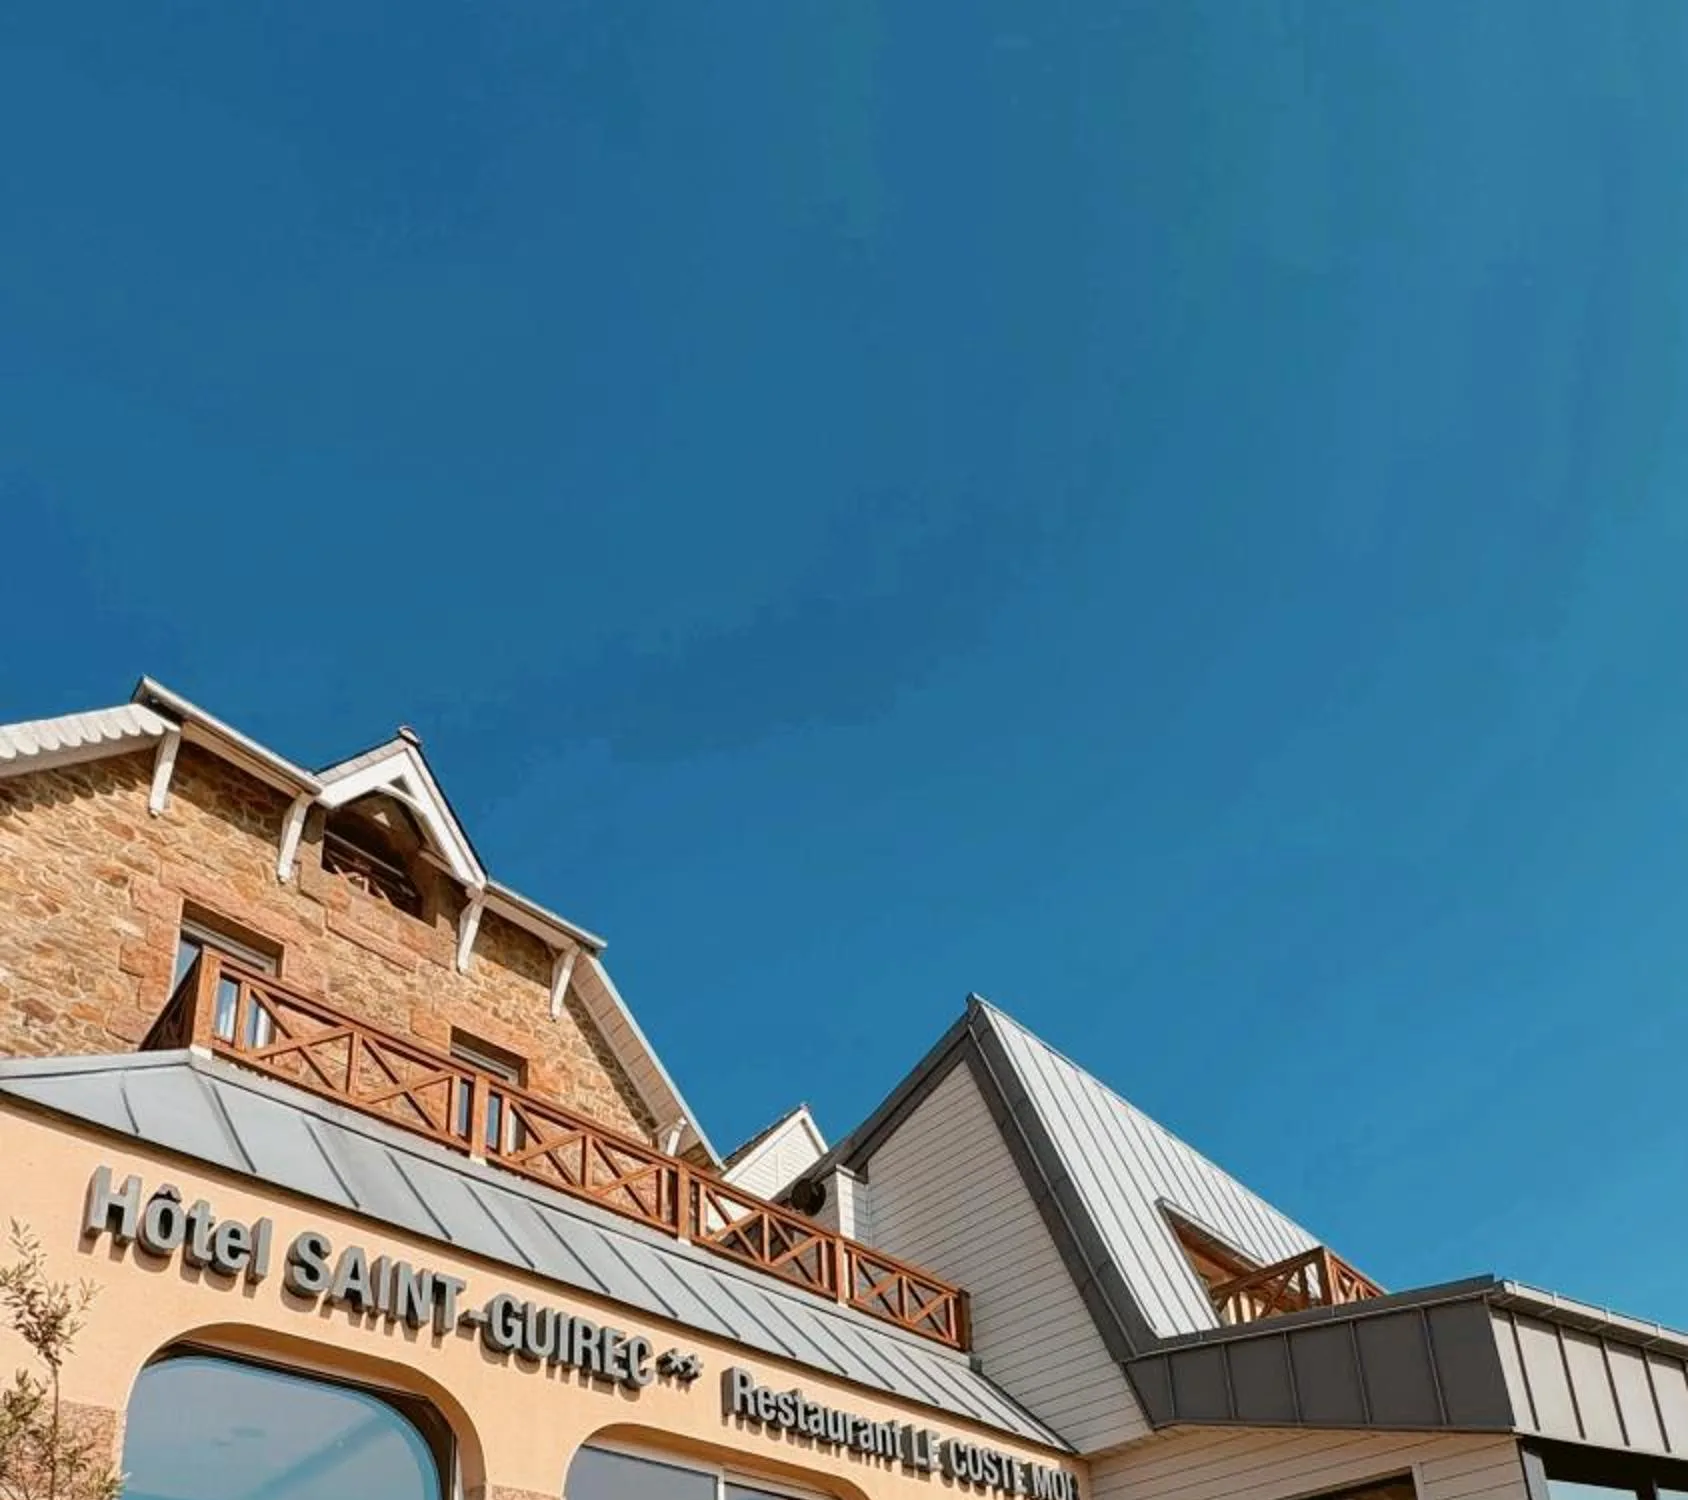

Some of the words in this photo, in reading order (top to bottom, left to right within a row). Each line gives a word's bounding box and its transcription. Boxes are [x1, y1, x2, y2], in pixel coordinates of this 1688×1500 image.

[84, 1165, 272, 1280] Hôtel
[285, 1230, 655, 1387] SAINT-GUIREC
[724, 1366, 904, 1460] Restaurant
[903, 1423, 943, 1472] LE
[942, 1436, 1028, 1495] COSTE
